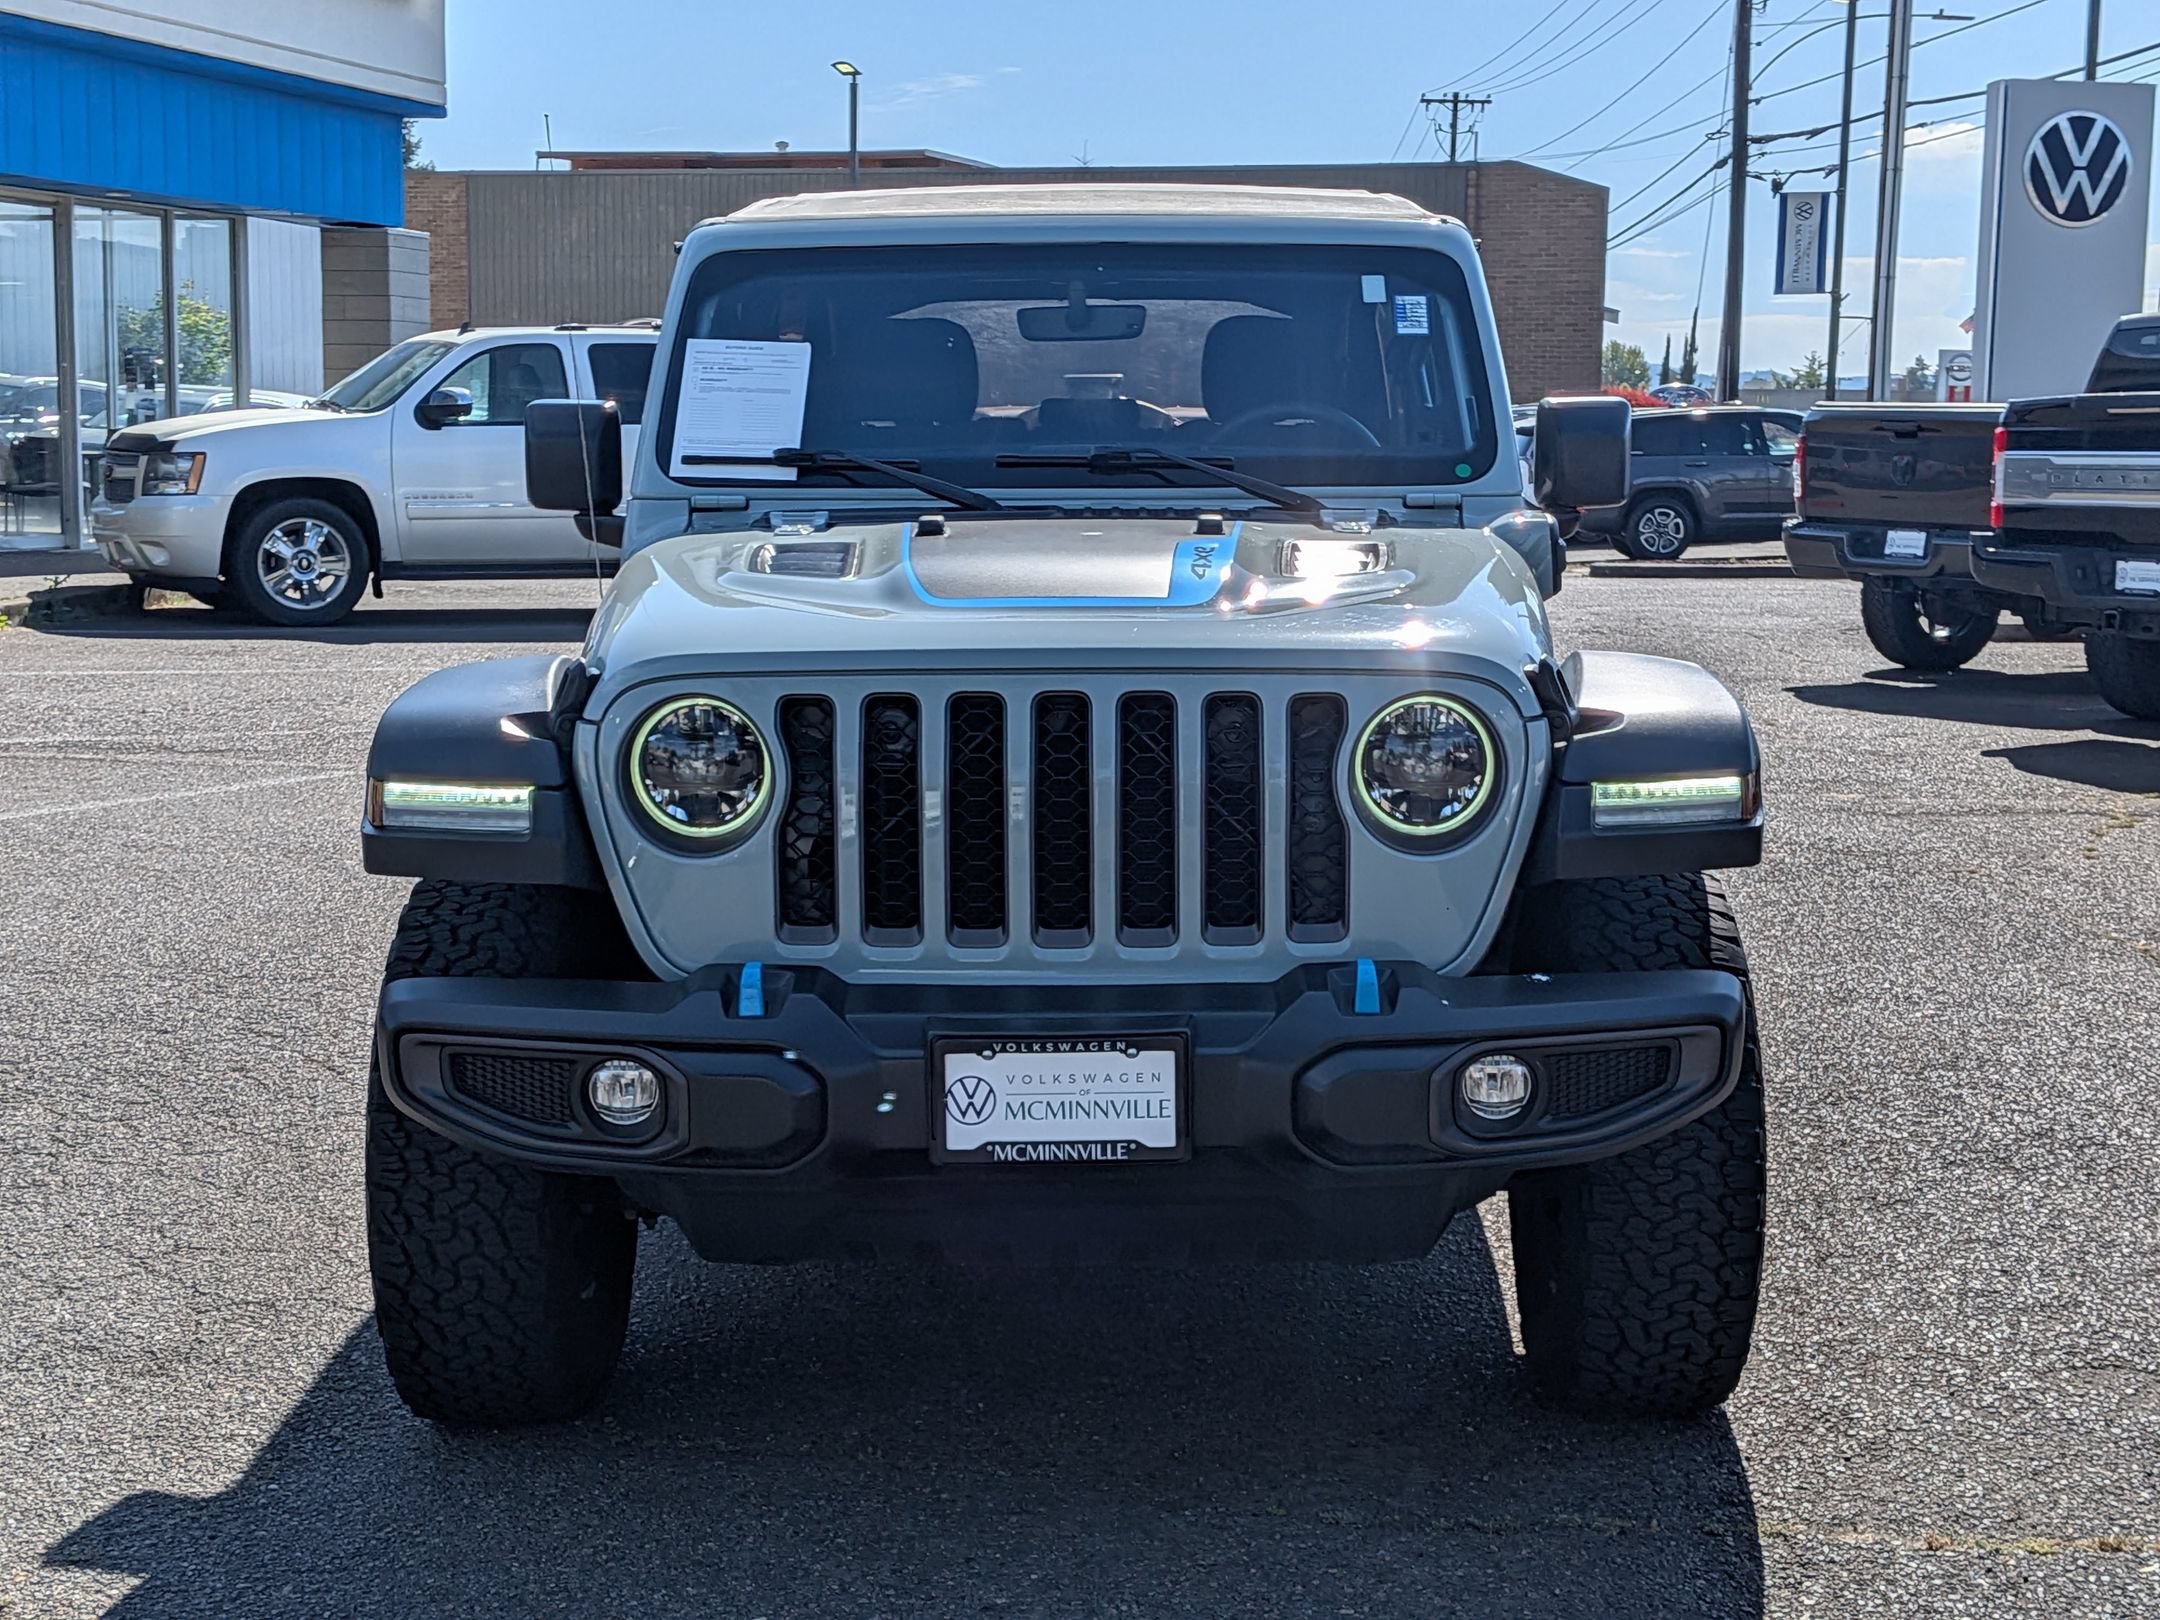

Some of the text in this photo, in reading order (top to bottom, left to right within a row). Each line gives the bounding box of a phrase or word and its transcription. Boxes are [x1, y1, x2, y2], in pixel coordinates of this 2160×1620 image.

[992, 1041, 1127, 1052] VOLKSWAGEN
[1006, 1072, 1162, 1085] VOLKSWAGEN
[1079, 1088, 1092, 1096] OF
[1004, 1099, 1172, 1121] MCMINNVILLE
[993, 1143, 1128, 1161] MCMINNVILLE
